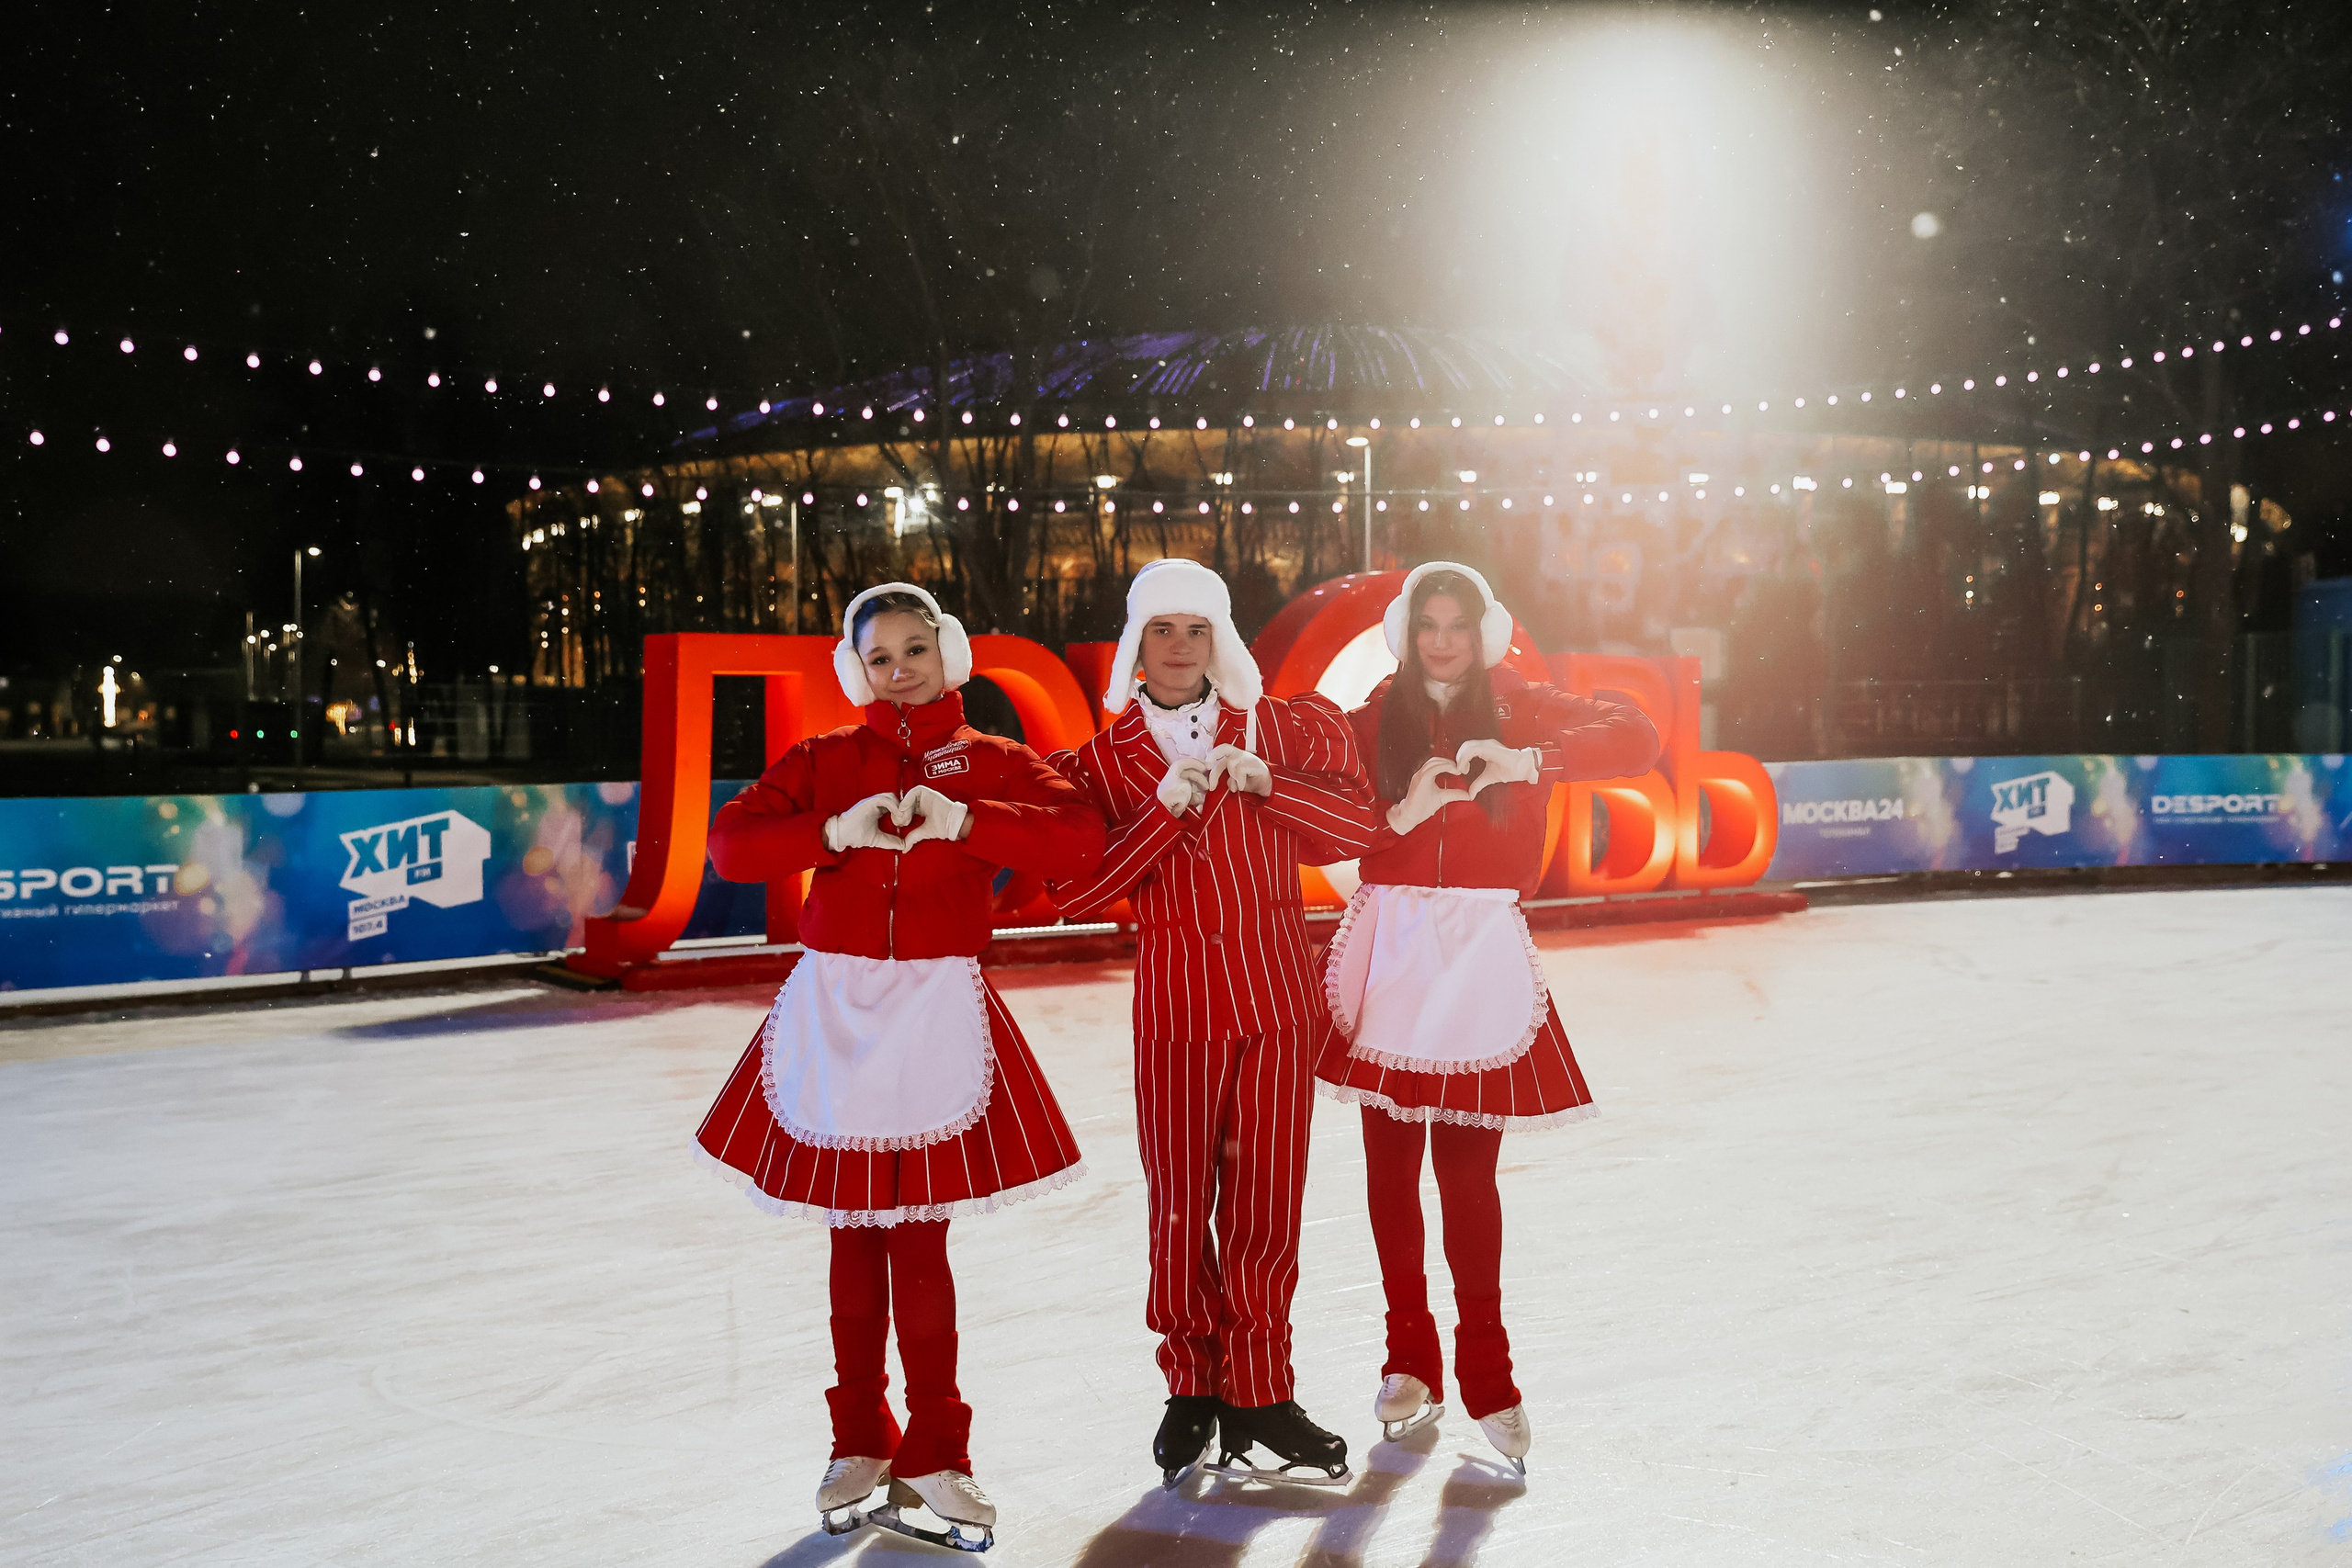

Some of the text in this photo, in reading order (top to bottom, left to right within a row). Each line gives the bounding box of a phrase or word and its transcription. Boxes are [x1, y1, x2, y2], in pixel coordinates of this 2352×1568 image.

[932, 759, 962, 772] ЗИМА
[1998, 777, 2051, 813] ХИТ
[2151, 794, 2282, 814] DESPORT
[1782, 798, 1904, 825] МОСКВА24
[350, 817, 450, 879] ХИТ
[354, 894, 406, 913] МОСКВА
